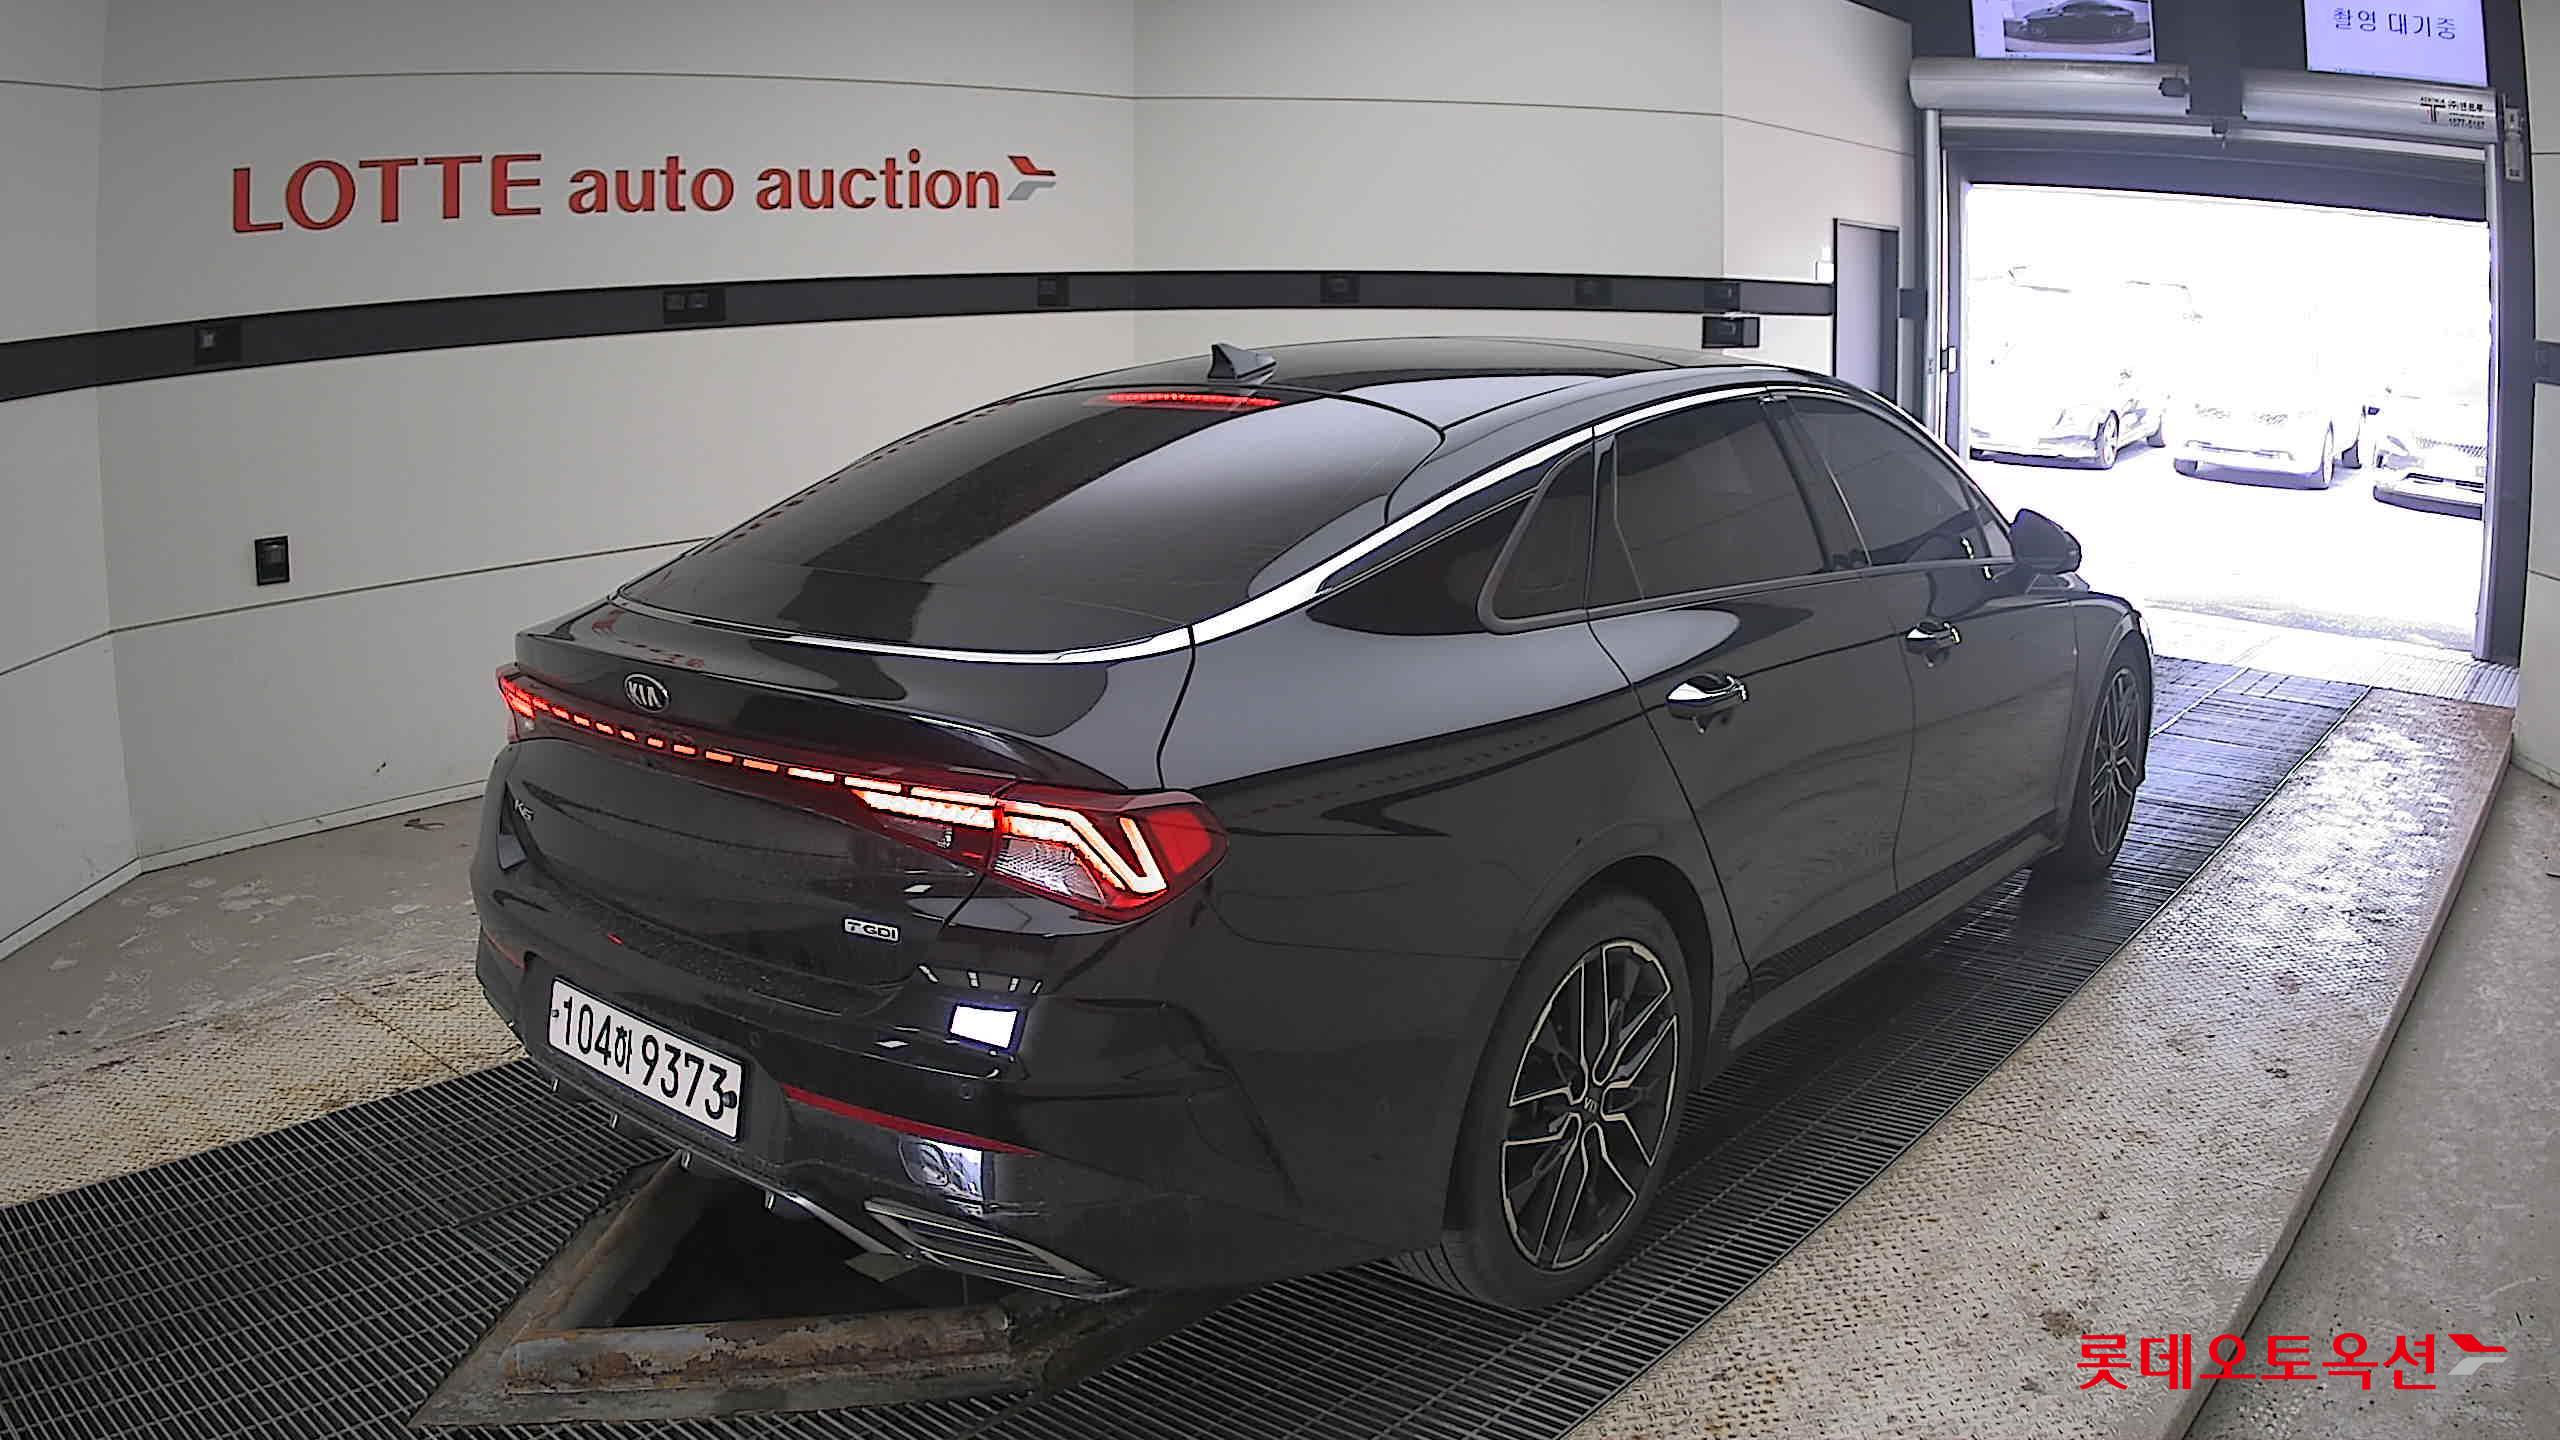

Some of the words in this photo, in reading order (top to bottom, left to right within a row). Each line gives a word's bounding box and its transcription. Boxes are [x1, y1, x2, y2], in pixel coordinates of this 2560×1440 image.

[2388, 12, 2457, 41] 대기중
[233, 153, 542, 232] LOTTE
[569, 155, 734, 214] auto
[756, 148, 1001, 210] auction
[628, 680, 663, 708] KIA
[863, 925, 896, 939] GDI
[563, 996, 633, 1074] 104하
[641, 1034, 728, 1120] 9373
